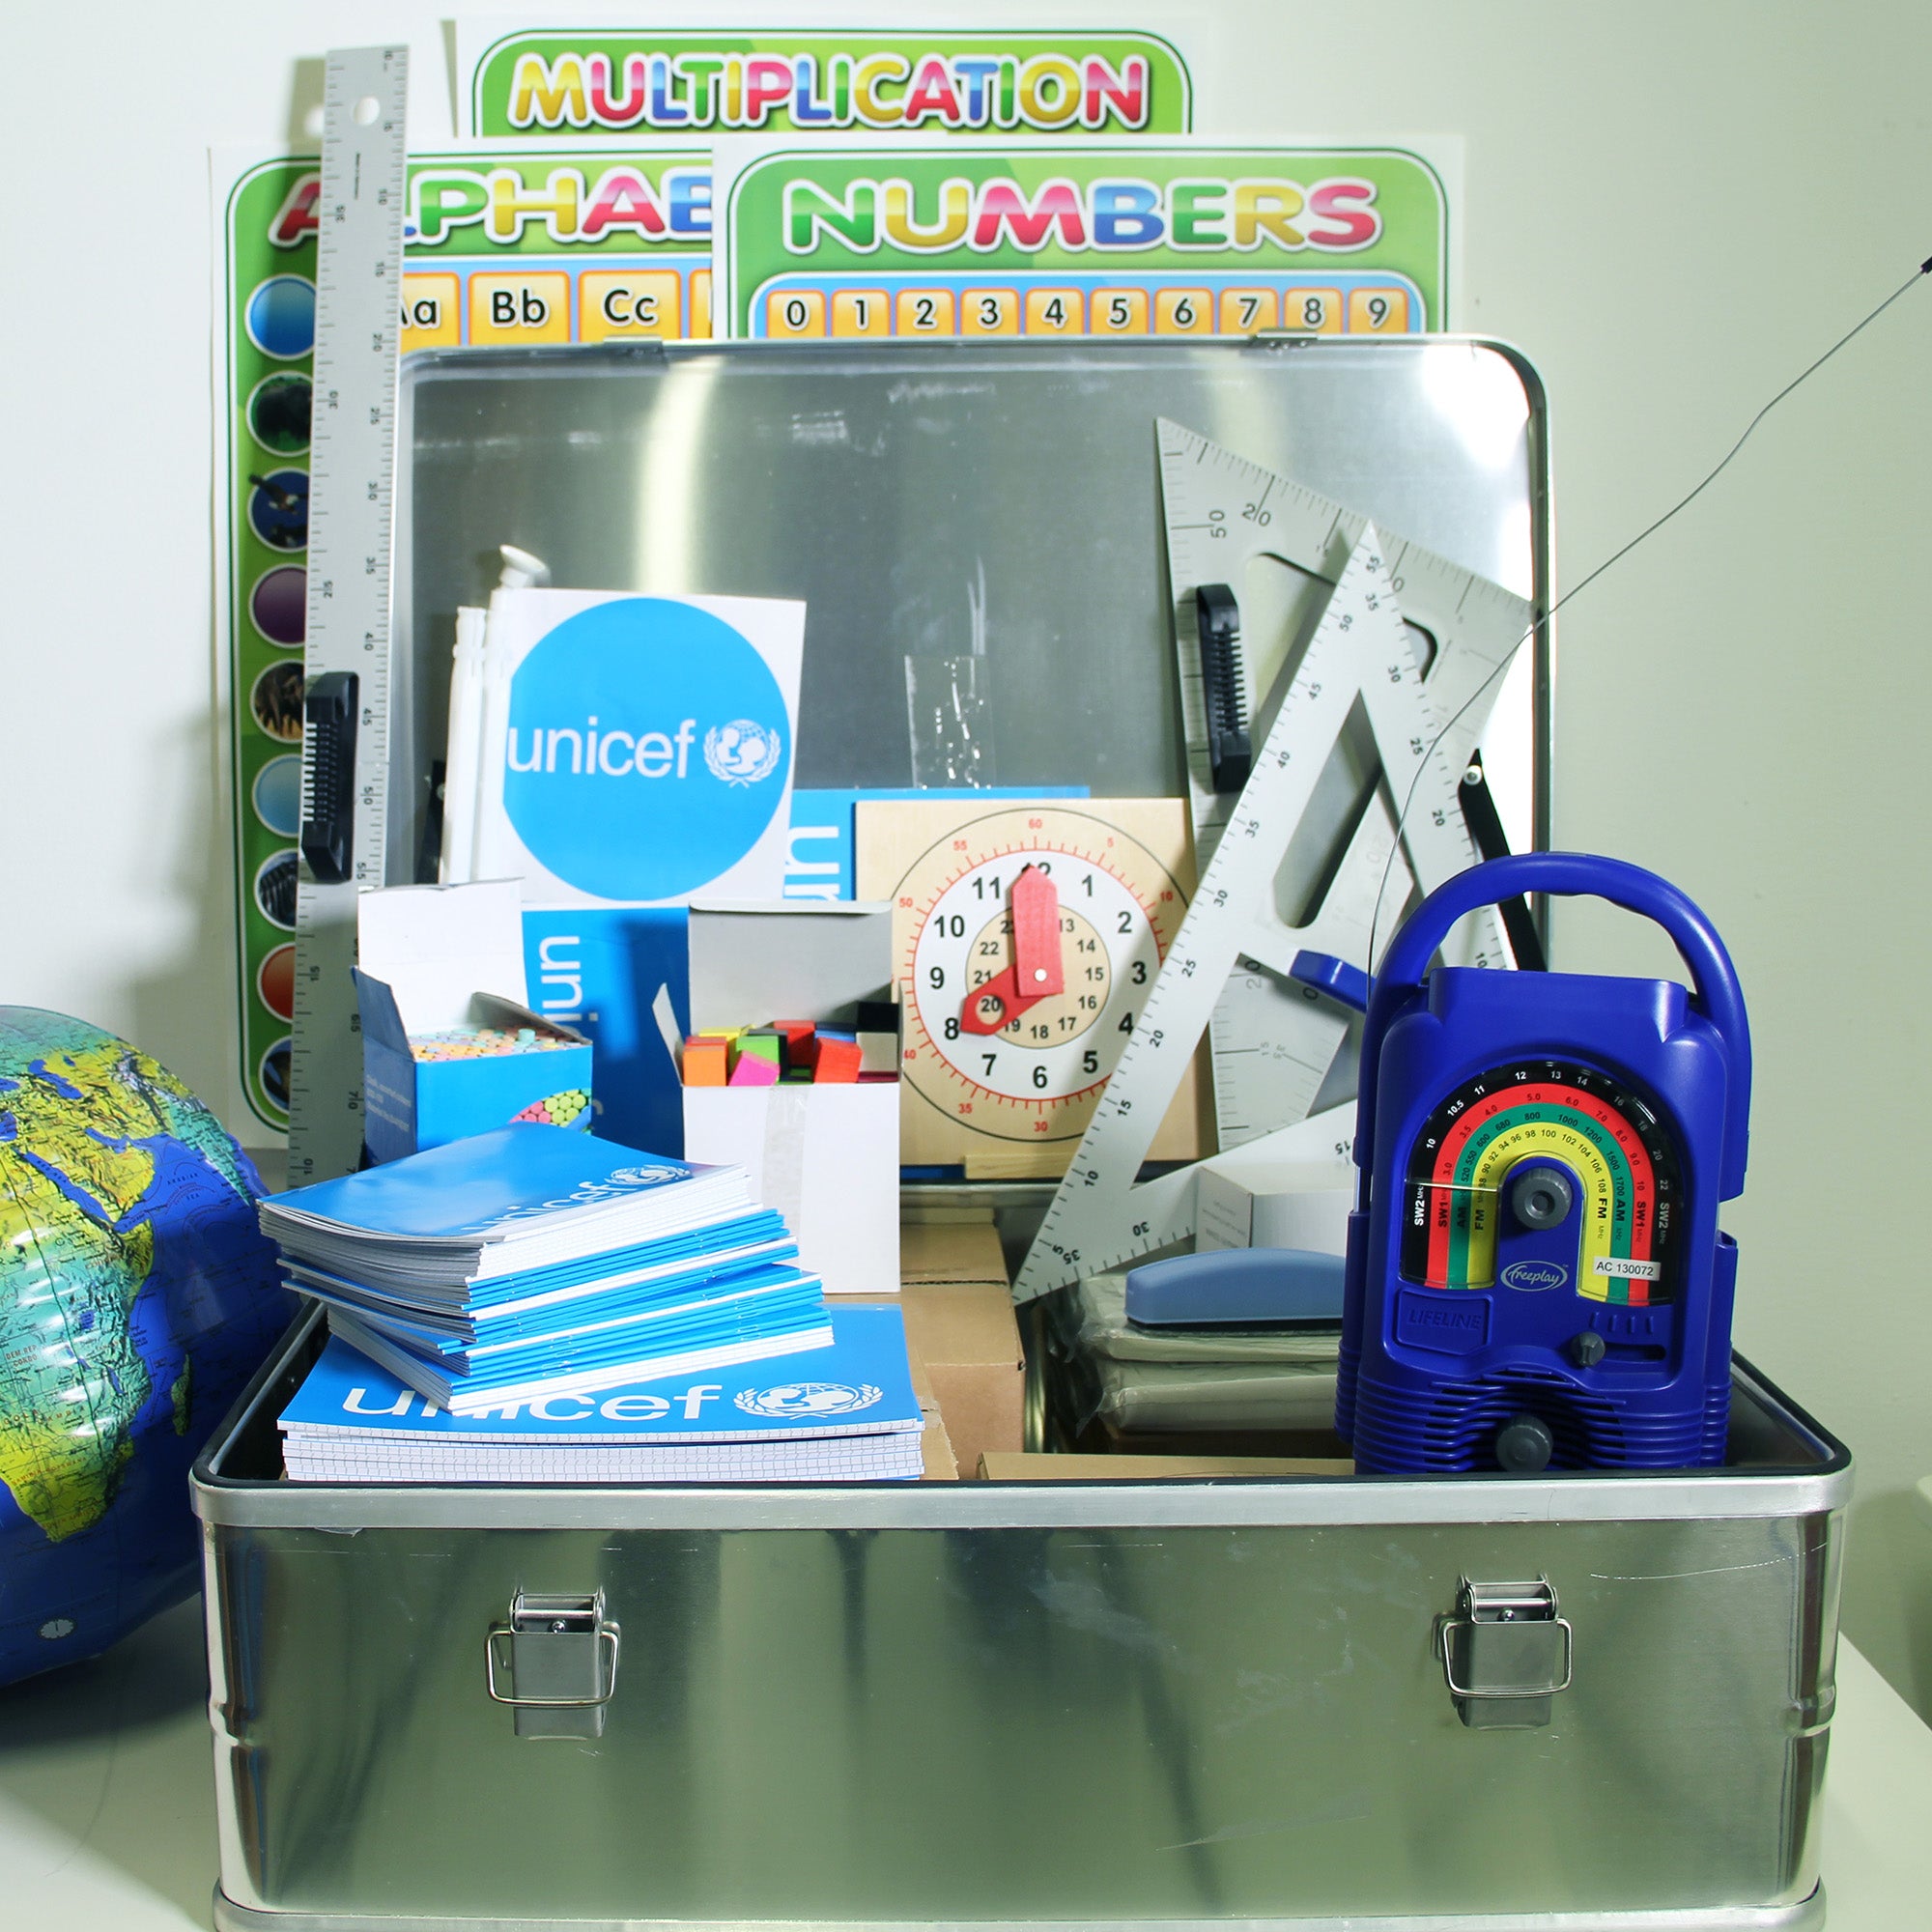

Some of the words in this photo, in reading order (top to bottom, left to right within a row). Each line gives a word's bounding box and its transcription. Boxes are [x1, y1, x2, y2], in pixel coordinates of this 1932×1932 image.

[511, 56, 1151, 127] MULTIPLICATION
[273, 174, 712, 240] APHAB
[787, 182, 1379, 250] NUMBERS
[402, 298, 437, 326] a
[492, 289, 547, 324] Bb
[604, 289, 658, 324] Cc
[786, 300, 806, 327] 0
[855, 300, 867, 327] 1
[916, 300, 934, 327] 2
[980, 300, 999, 326] 3
[1045, 299, 1065, 326] 4
[1109, 299, 1128, 326] 5
[1175, 299, 1193, 326] 6
[1238, 298, 1259, 326] 7
[1303, 298, 1322, 326] 8
[1368, 298, 1387, 325] 9
[373, 332, 383, 353] 20
[370, 407, 380, 425] 25
[368, 482, 378, 501] 30
[1242, 503, 1271, 526] 20
[366, 556, 376, 575] 35
[1366, 555, 1379, 573] 55
[1339, 614, 1352, 633] 50
[364, 632, 374, 651] 40
[1307, 684, 1321, 701] 45
[363, 707, 373, 726] 45
[1365, 594, 1379, 611] 35
[1388, 666, 1401, 683] 30
[1409, 738, 1424, 755] 25
[1432, 810, 1445, 827] 20
[508, 716, 695, 779] unicef
[1208, 510, 1227, 538] 50
[1244, 960, 1263, 988] 20
[1276, 752, 1291, 769] 40
[302, 1157, 314, 1176] 10
[310, 965, 321, 981] 15
[323, 580, 333, 599] 25
[329, 390, 338, 410] 30
[363, 786, 374, 806] 50
[1028, 818, 1042, 830] 60
[1244, 822, 1260, 838] 35
[953, 839, 967, 851] 55
[1107, 837, 1114, 848] 5
[356, 862, 367, 881] 55
[972, 877, 1000, 899] 11
[1082, 874, 1094, 896] 1
[899, 897, 913, 908] 50
[1214, 890, 1228, 907] 30
[933, 915, 965, 937] 10
[1118, 911, 1132, 934] 2
[980, 942, 999, 954] 22
[1077, 940, 1094, 952] 14
[1085, 968, 1103, 980] 15
[1131, 961, 1146, 984] 3
[1181, 958, 1197, 977] 25
[930, 967, 945, 989] 9
[974, 970, 991, 983] 21
[980, 998, 1001, 1011] 20
[1078, 996, 1096, 1009] 16
[351, 1013, 361, 1034] 65
[945, 1018, 959, 1040] 8
[1005, 1018, 1020, 1032] 19
[1030, 1026, 1048, 1038] 18
[1058, 1018, 1076, 1031] 17
[1118, 1012, 1134, 1035] 4
[1150, 1030, 1165, 1048] 20
[903, 1049, 916, 1060] 40
[1083, 1051, 1098, 1073] 5
[981, 1054, 996, 1076] 7
[1033, 1066, 1047, 1089] 6
[1515, 1071, 1526, 1080] 12
[1551, 1070, 1562, 1080] 13
[1577, 1075, 1588, 1086] 14
[1474, 1085, 1485, 1094] 11
[348, 1091, 358, 1110] 70
[958, 1102, 973, 1114] 35
[1117, 1100, 1132, 1117] 15
[1448, 1100, 1464, 1117] 10.5
[1565, 1096, 1579, 1107] 6.0
[1614, 1095, 1624, 1106] 16
[1485, 1105, 1497, 1116] 4.0
[1524, 1112, 1540, 1121] 800
[1595, 1111, 1608, 1122] 7.0
[1035, 1122, 1048, 1132] 30
[1495, 1119, 1511, 1131] 680
[1558, 1114, 1578, 1127] 1000
[1476, 1133, 1491, 1148] 600
[1511, 1133, 1521, 1143] 96
[1525, 1129, 1536, 1138] 98
[1541, 1129, 1557, 1138] 100
[1561, 1133, 1577, 1146] 102
[1583, 1125, 1603, 1144] 1200
[1335, 1141, 1350, 1154] 15
[1426, 1138, 1435, 1149] 10
[1498, 1141, 1509, 1151] 94
[1577, 1143, 1592, 1158] 104
[1465, 1150, 1477, 1165] 550
[1489, 1151, 1499, 1162] 92
[1606, 1151, 1620, 1171] 1500
[1653, 1150, 1662, 1161] 20
[1461, 1167, 1471, 1181] 520
[1481, 1163, 1491, 1174] 90
[1590, 1158, 1604, 1174] 106
[1084, 1171, 1099, 1187] 10
[1598, 1179, 1606, 1194] 108
[1615, 1177, 1625, 1197] 1700
[1636, 1180, 1645, 1191] 10
[1660, 1179, 1668, 1191] 22
[1414, 1199, 1426, 1226] SW2
[1438, 1201, 1448, 1228] SW1
[1598, 1198, 1607, 1219] FM
[1616, 1199, 1626, 1222] AM
[1635, 1201, 1646, 1228] SW1
[1659, 1202, 1670, 1229] SW2
[1457, 1207, 1466, 1228] AM
[1475, 1208, 1485, 1231] FM
[1132, 1221, 1150, 1236] 30
[1052, 1244, 1064, 1256] 5
[1064, 1249, 1080, 1264] 35
[1597, 1262, 1613, 1271] AC
[1617, 1264, 1654, 1276] 130072
[1407, 1310, 1482, 1330] LIFELINE
